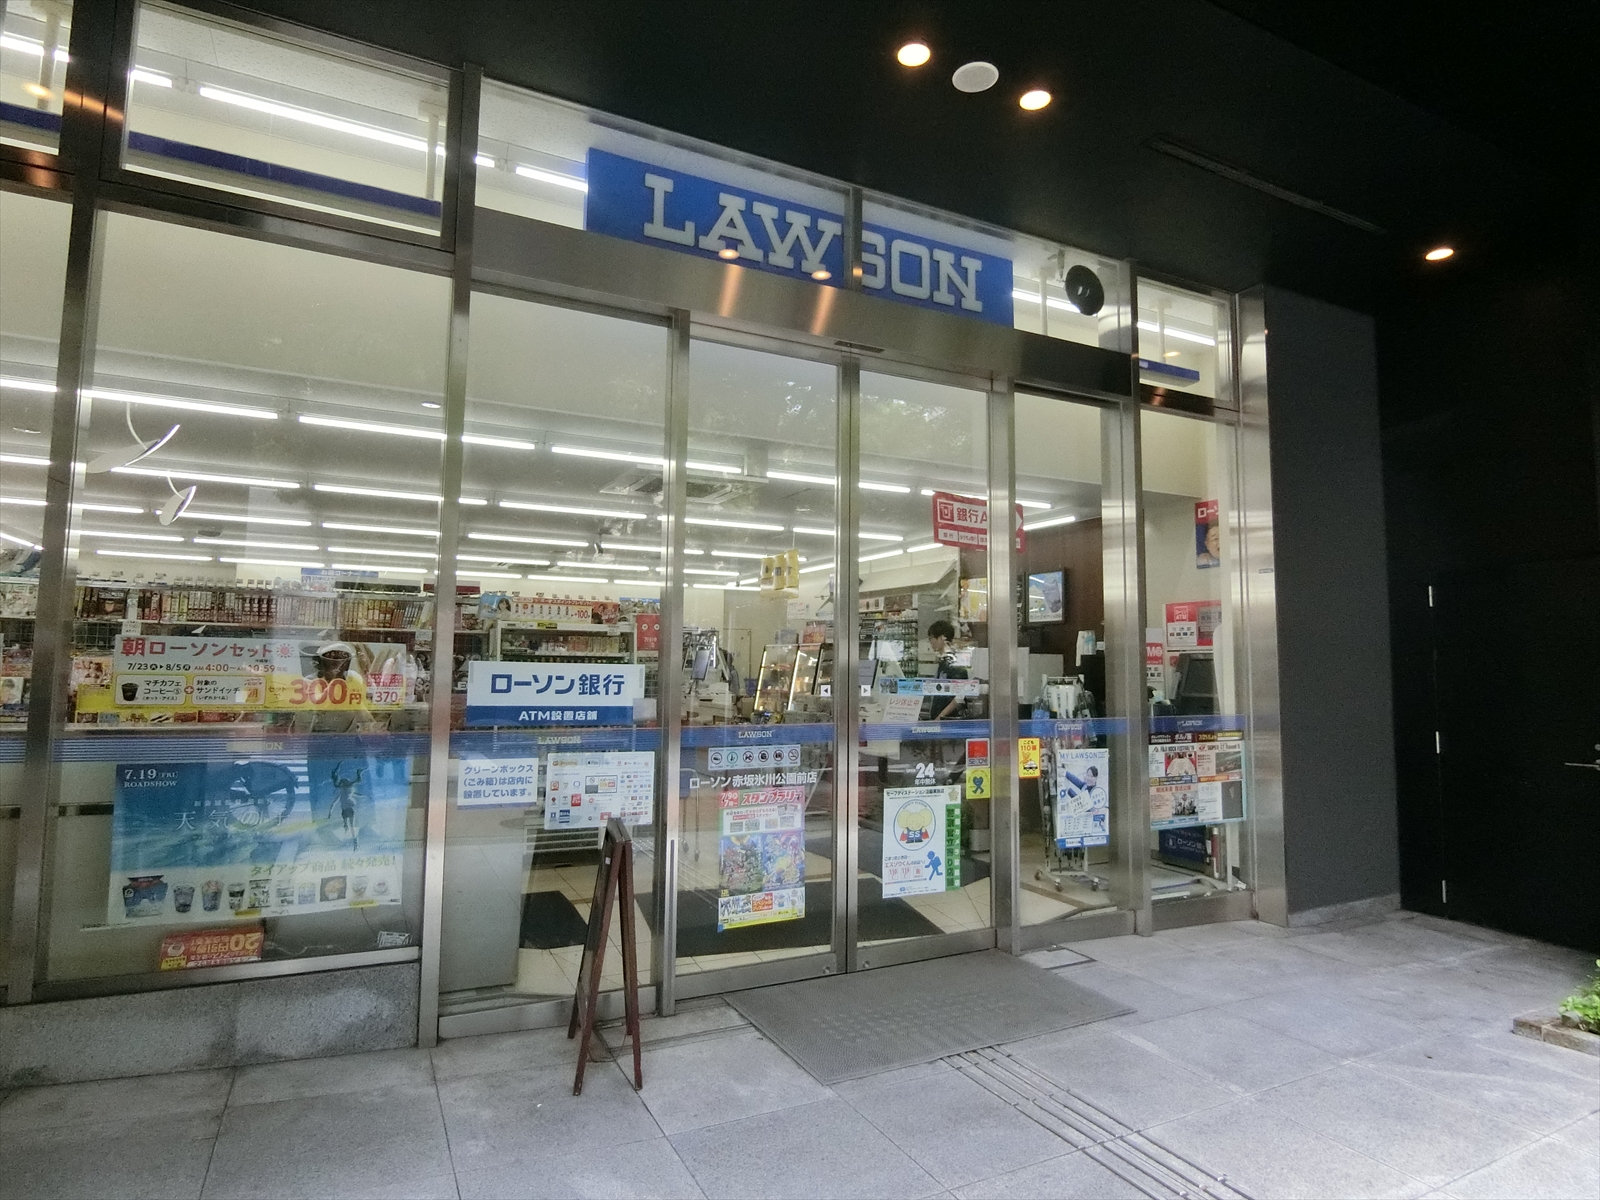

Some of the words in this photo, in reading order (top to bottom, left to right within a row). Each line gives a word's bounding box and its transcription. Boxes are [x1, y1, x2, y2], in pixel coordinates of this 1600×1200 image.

[643, 172, 984, 313] LAWSON
[120, 636, 273, 658] 朝ローソンセット
[143, 679, 182, 687] マチカフェ
[490, 673, 625, 696] ローソン銀行
[518, 710, 598, 721] ATM設置店舗
[738, 730, 774, 739] LAWSON
[1059, 752, 1069, 760] MY
[1070, 751, 1098, 760] LAWSON
[124, 769, 157, 780] 7.19
[464, 764, 534, 775] クリーンボックス
[915, 762, 935, 779] 24
[123, 779, 178, 788] ROADSHOW
[740, 788, 804, 806] スタンプラリー
[909, 830, 921, 838] SS
